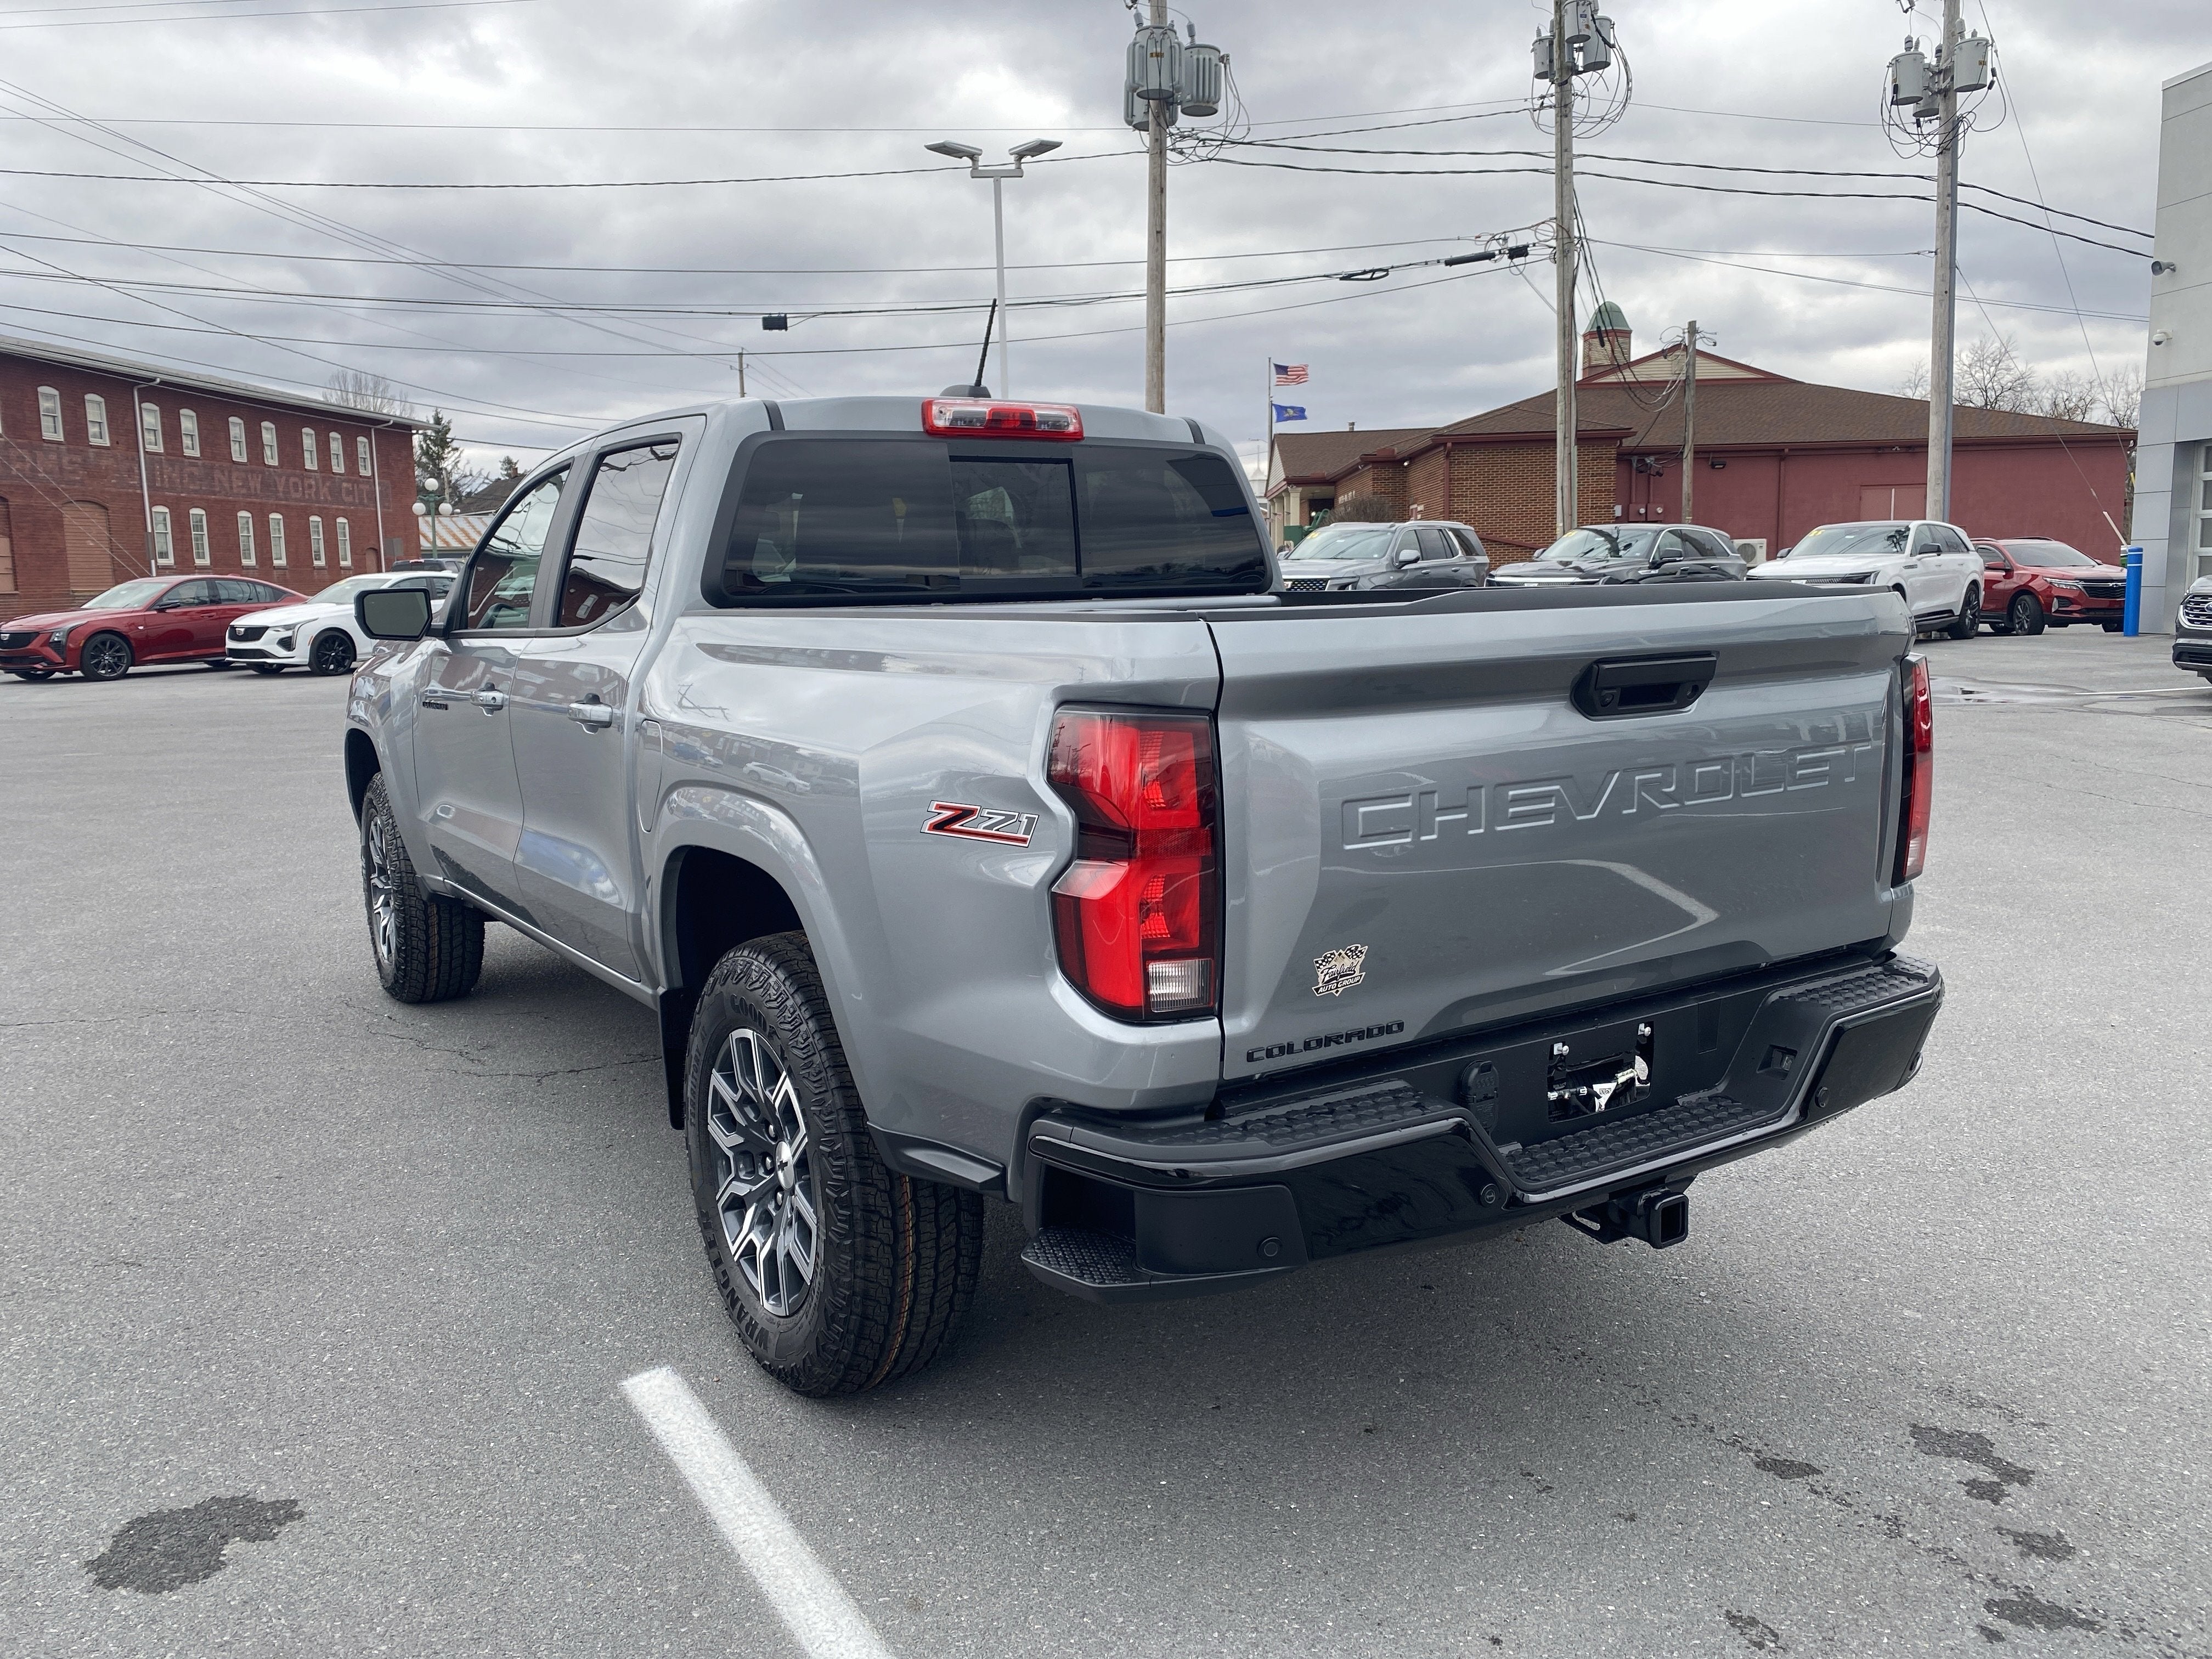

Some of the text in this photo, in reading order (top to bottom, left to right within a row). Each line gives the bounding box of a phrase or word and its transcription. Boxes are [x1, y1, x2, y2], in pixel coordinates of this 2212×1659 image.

[214, 467, 262, 495] NEW
[275, 476, 331, 501] YORK
[341, 482, 376, 503] CIT
[1342, 738, 1872, 850] CHEVROLET
[920, 800, 1039, 848] Z71
[1318, 977, 1361, 994] AUTO GROUP
[1246, 1019, 1404, 1063] COLORADO
[700, 1209, 769, 1352] WRANGLER
